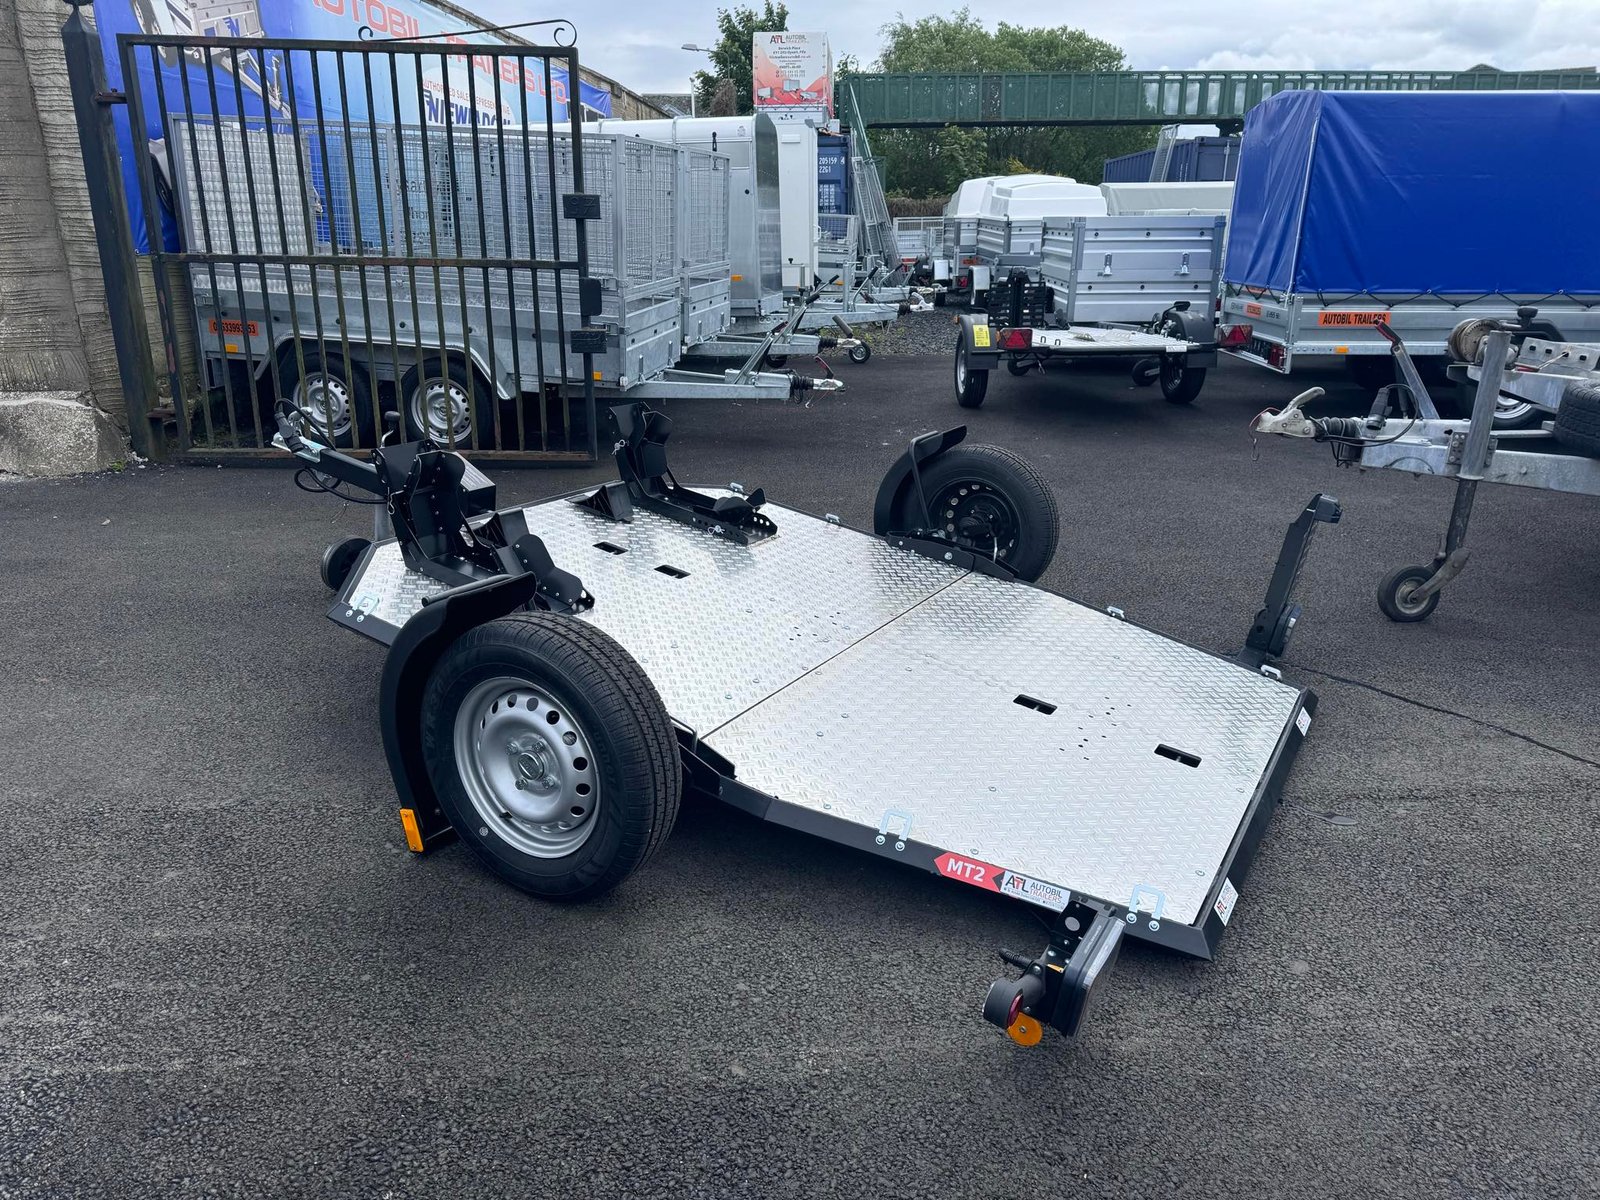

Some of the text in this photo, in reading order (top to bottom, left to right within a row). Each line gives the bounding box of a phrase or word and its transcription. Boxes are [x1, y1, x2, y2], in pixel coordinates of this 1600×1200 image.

[1322, 313, 1352, 325] AUTOBIL
[947, 858, 986, 882] MT2
[1005, 874, 1030, 893] ATL
[1030, 882, 1063, 899] AUTOBIL
[1030, 890, 1062, 904] TRAILERS
